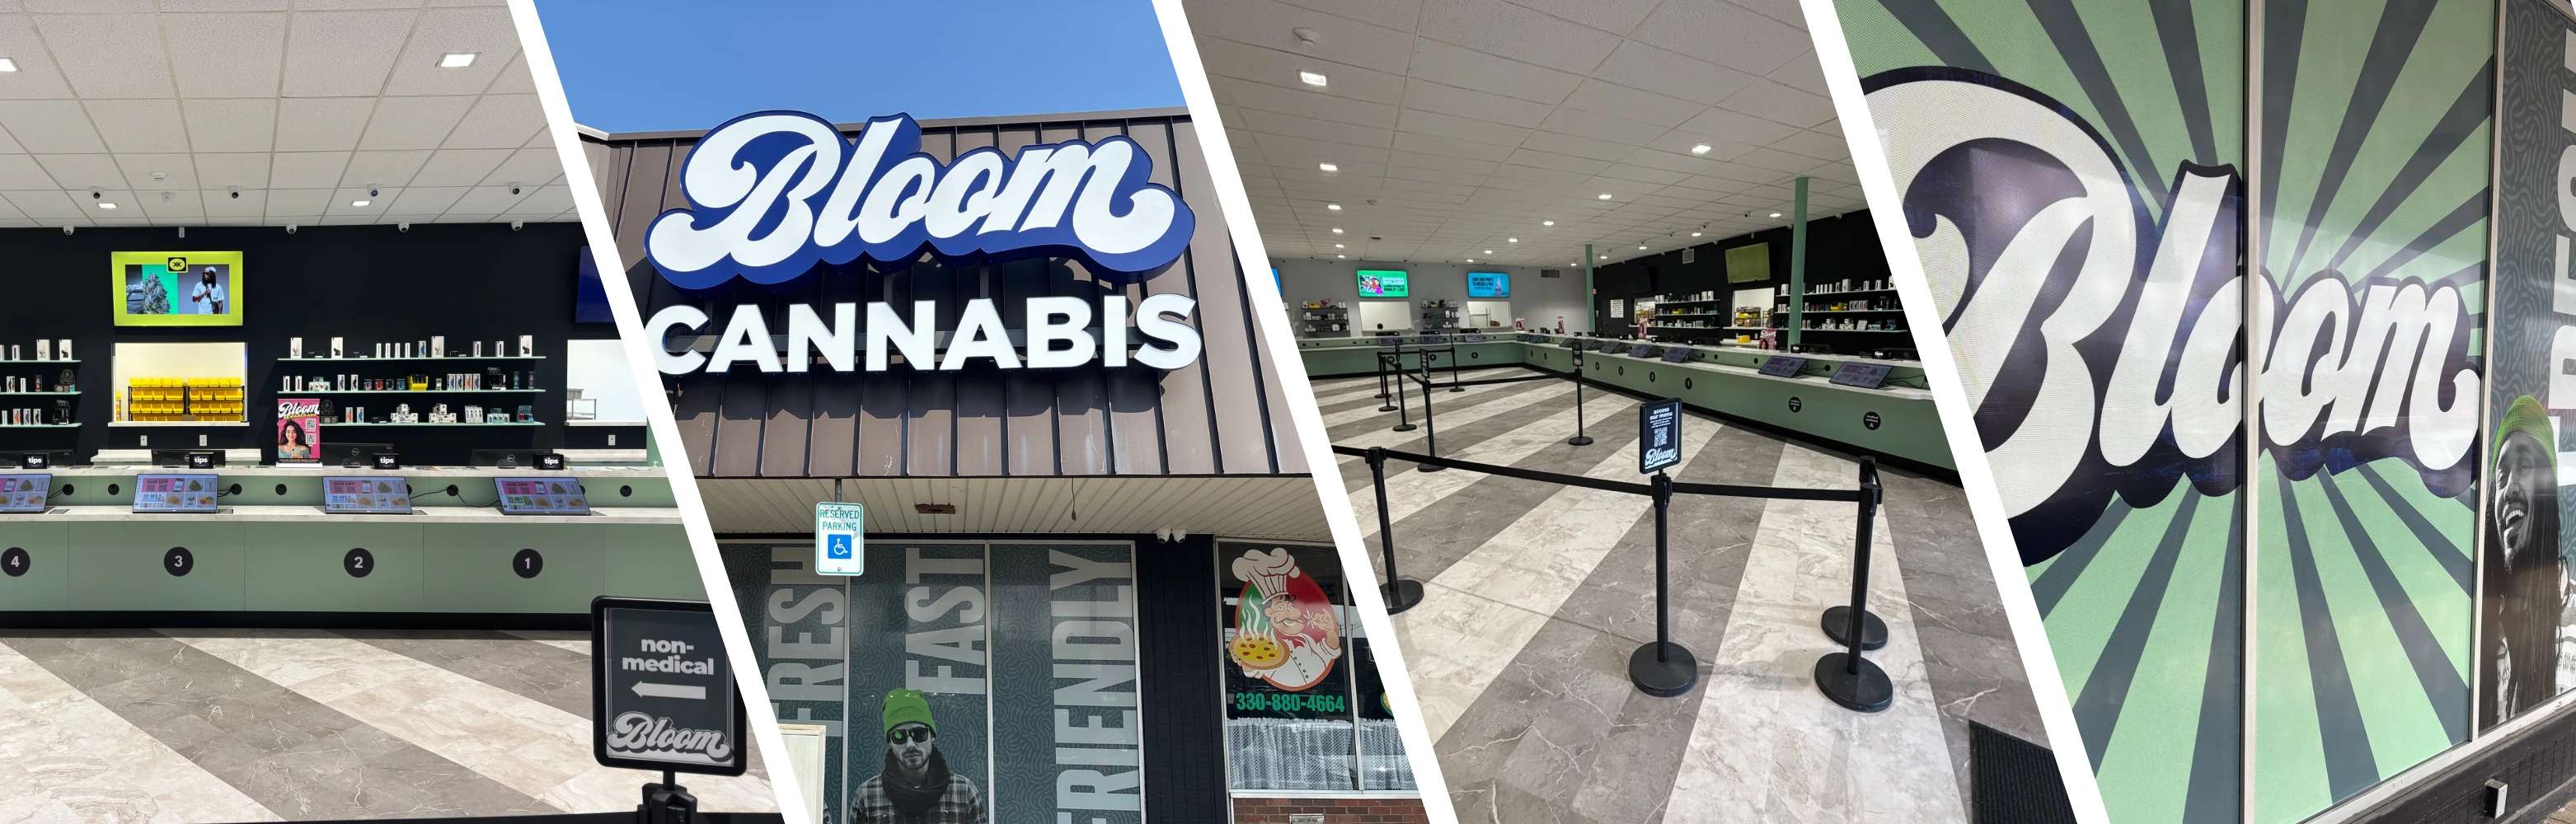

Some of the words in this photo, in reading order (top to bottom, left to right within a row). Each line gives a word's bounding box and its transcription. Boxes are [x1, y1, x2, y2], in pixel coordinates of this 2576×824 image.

[649, 115, 1175, 273] Bloom
[1860, 79, 2480, 521] Bloom
[645, 293, 1202, 376] CANNABIS
[278, 402, 320, 419] Bloom
[27, 456, 43, 465] tips
[194, 456, 208, 465] tips
[380, 456, 395, 465] tips
[544, 457, 559, 466] tips
[1645, 448, 1676, 467] Bloom
[819, 509, 860, 519] RESERVED
[822, 521, 857, 531] PARKING
[11, 555, 20, 567] 4
[174, 555, 183, 567] 3
[354, 557, 364, 568] 2
[523, 558, 531, 569] 1
[904, 547, 986, 695] FAST
[640, 639, 694, 653] non-
[622, 654, 715, 676] medical
[1236, 693, 1345, 713] 330-880-4664
[607, 711, 733, 761] Bloom
